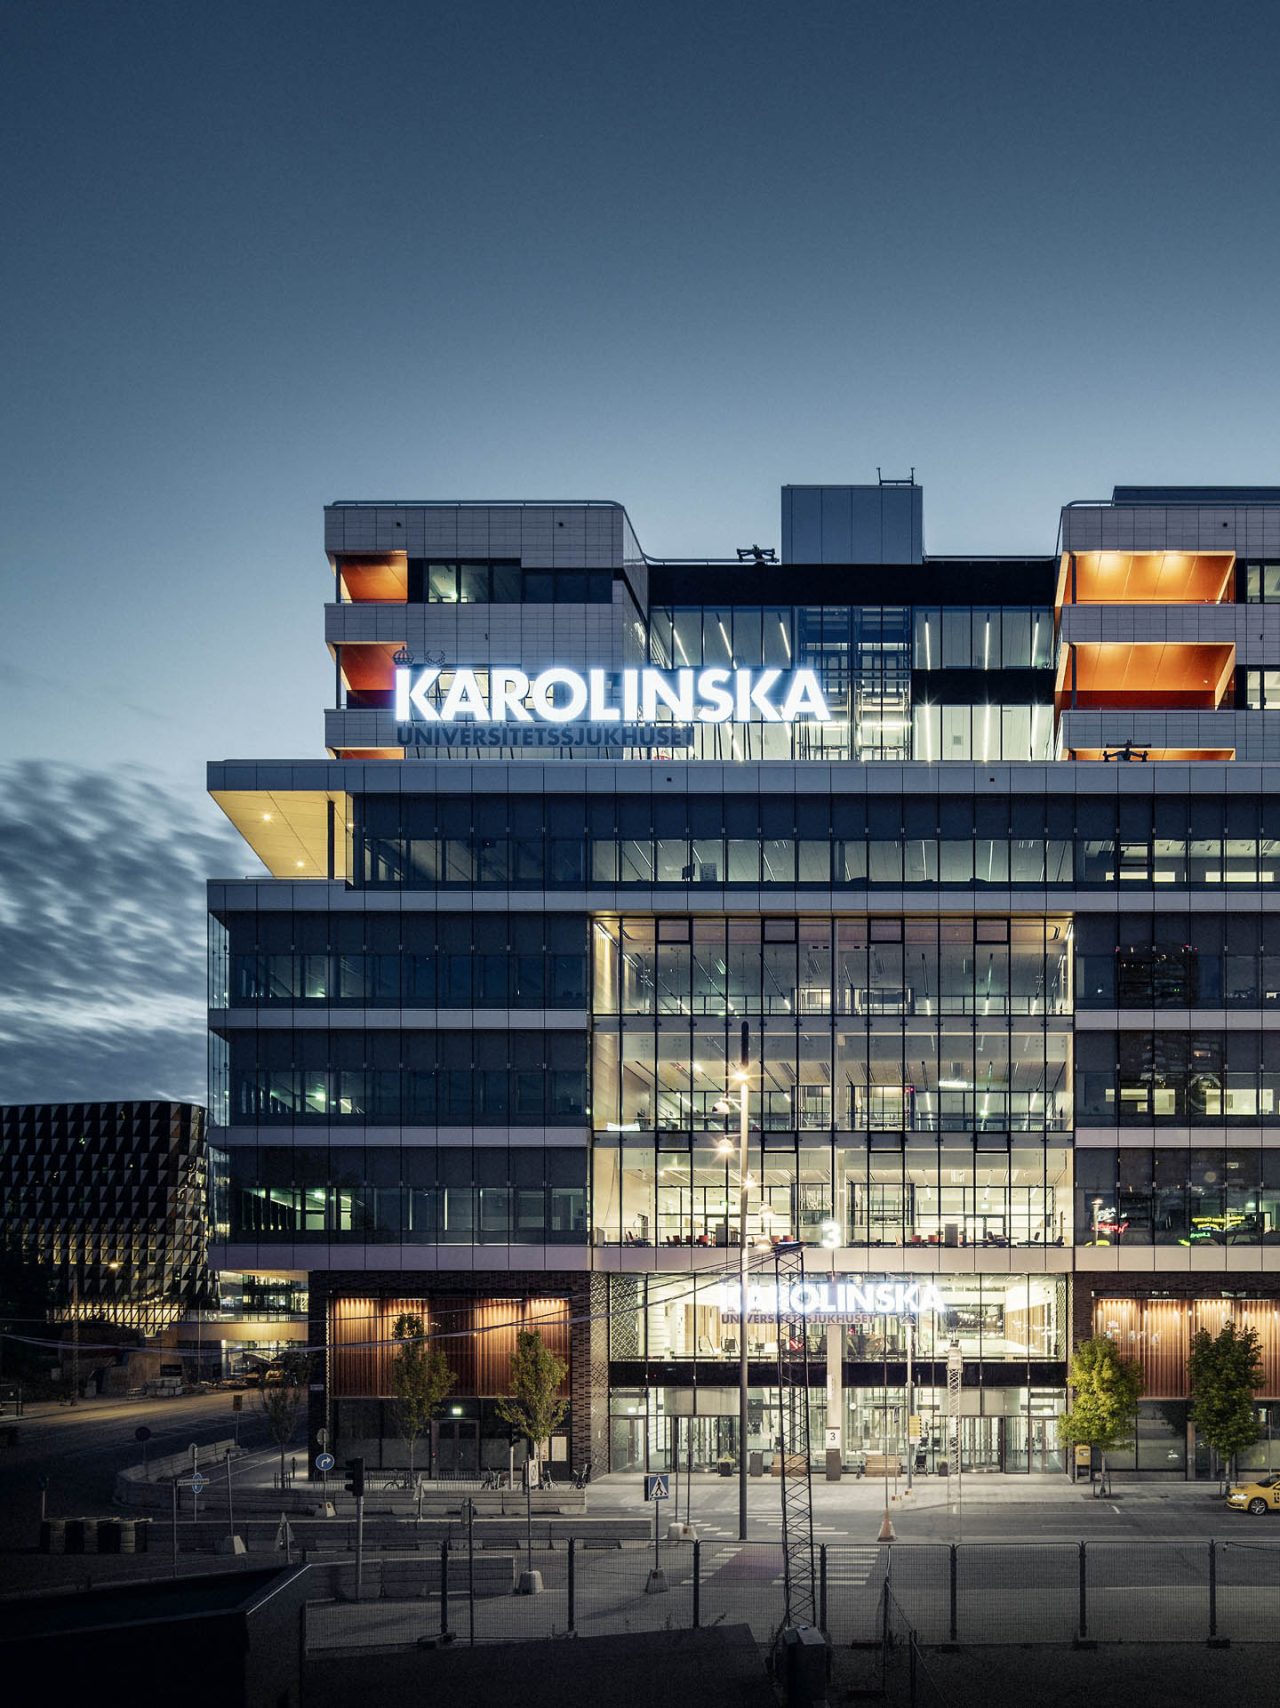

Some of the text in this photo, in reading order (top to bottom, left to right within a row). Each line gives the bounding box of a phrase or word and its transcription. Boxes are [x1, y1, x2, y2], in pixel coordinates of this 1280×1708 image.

[394, 667, 832, 722] KAROLINSKA
[397, 727, 694, 746] UNIVERSITETSSJUKHUSET
[822, 1221, 841, 1248] 3
[720, 1282, 946, 1313] OLINSKA
[721, 1313, 875, 1324] UNERSETSJUKHUSET
[830, 1432, 836, 1441] 3
